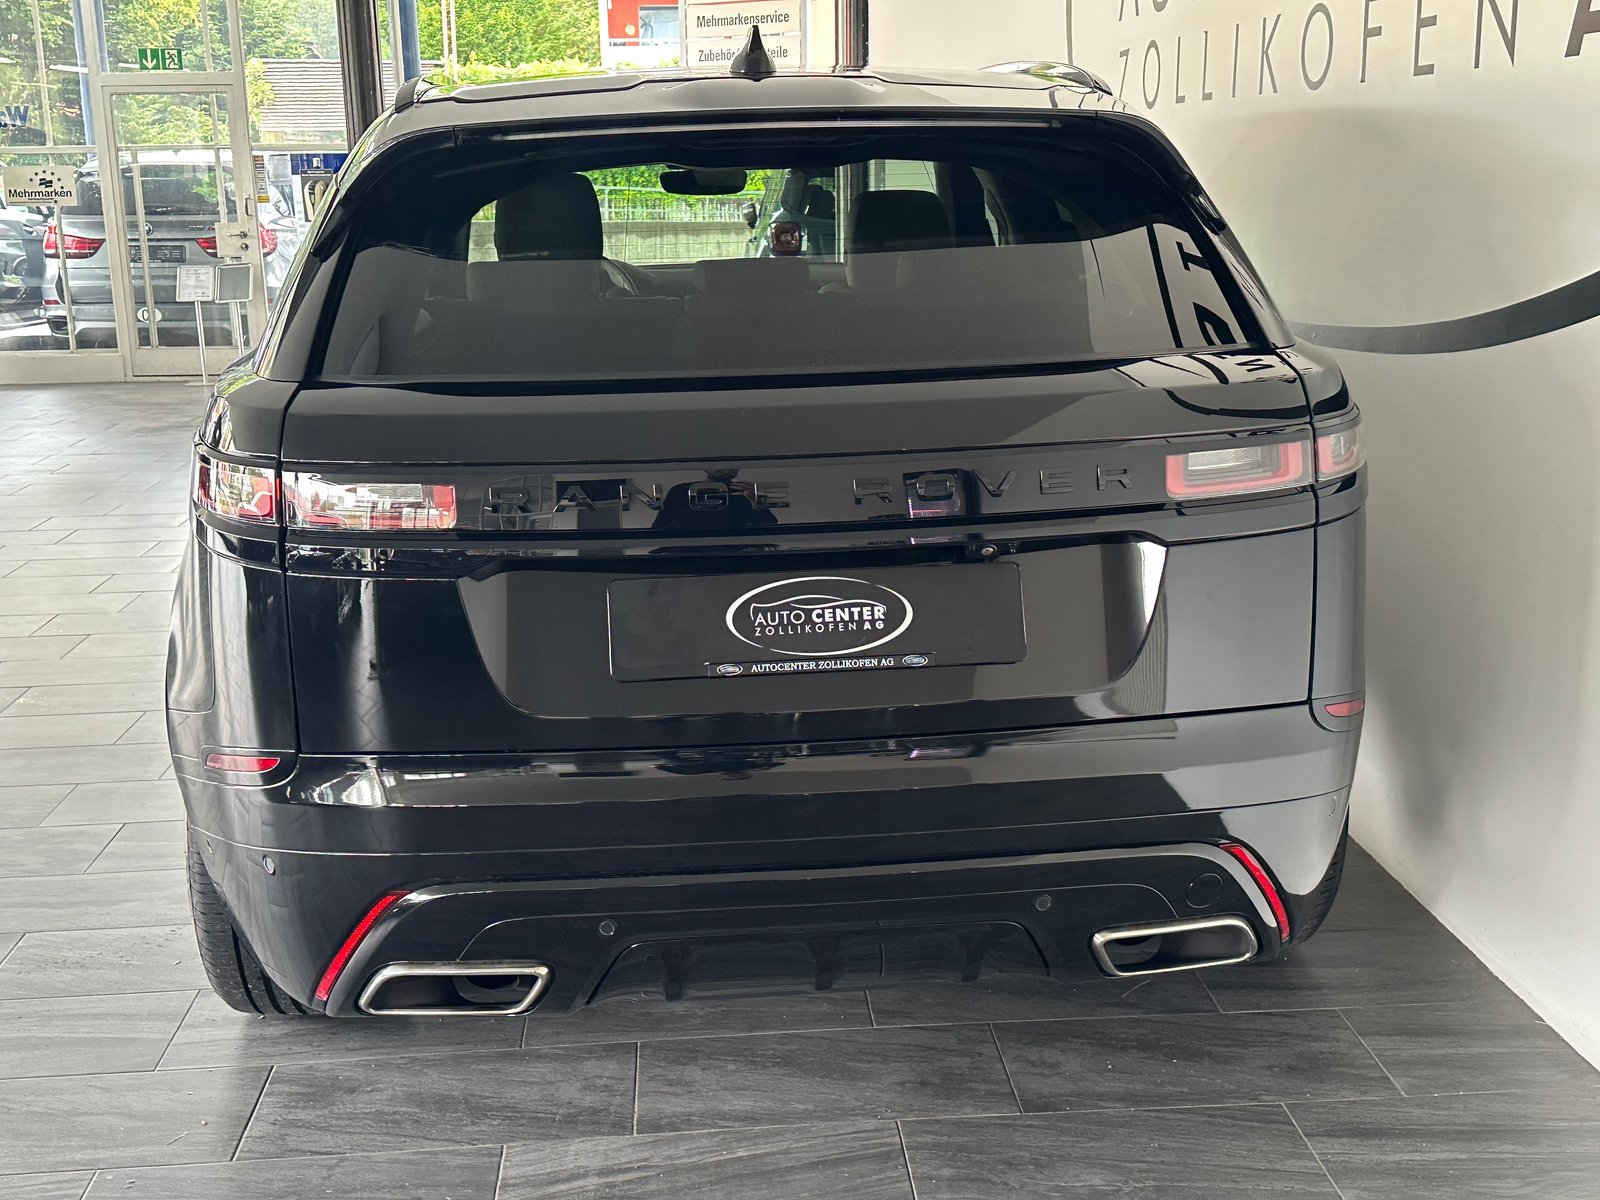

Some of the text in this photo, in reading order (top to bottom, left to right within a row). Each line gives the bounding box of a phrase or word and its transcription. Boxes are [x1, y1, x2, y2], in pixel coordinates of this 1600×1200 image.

[696, 10, 790, 28] Mehrmarkenservice
[8, 188, 73, 198] Mehrmarken
[488, 464, 1135, 513] RANGE ROVER
[754, 606, 885, 626] AUTO CENTER
[754, 620, 885, 637] ZOLLIKOFEN AG
[751, 661, 816, 673] AUTOCENTER
[818, 658, 878, 670] ZOLLIKOFEN
[880, 657, 894, 667] AG
